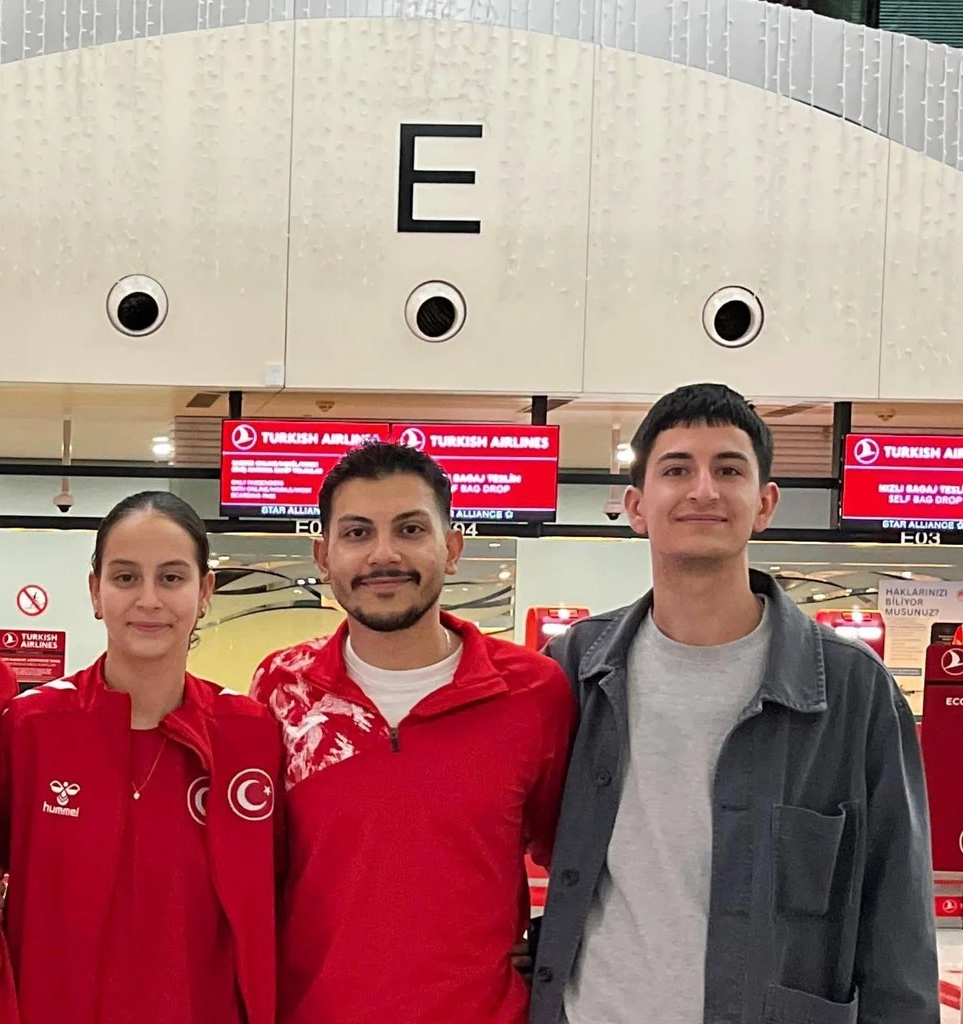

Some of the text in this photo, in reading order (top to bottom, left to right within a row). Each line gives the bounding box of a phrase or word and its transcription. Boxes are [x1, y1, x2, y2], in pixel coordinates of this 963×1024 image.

[397, 123, 483, 234] E
[261, 432, 318, 445] TURKISH
[430, 435, 549, 449] TURKISH AIRLINES
[883, 446, 941, 459] TURKISH
[460, 484, 480, 493] BAG
[483, 485, 511, 493] DROP
[888, 495, 963, 505] SELF BAG DROP
[261, 506, 321, 515] STAR ALLIAN
[456, 510, 503, 519] ALLIANCE
[296, 520, 322, 534] E0
[882, 520, 955, 530] STAR ALLIANCE
[900, 531, 941, 545] E03
[885, 597, 924, 606] BİLİYOR
[885, 608, 940, 616] MUSUNUZ?
[21, 633, 58, 641] TURKISH
[20, 640, 58, 649] AIRLINES
[42, 800, 80, 818] hummel
